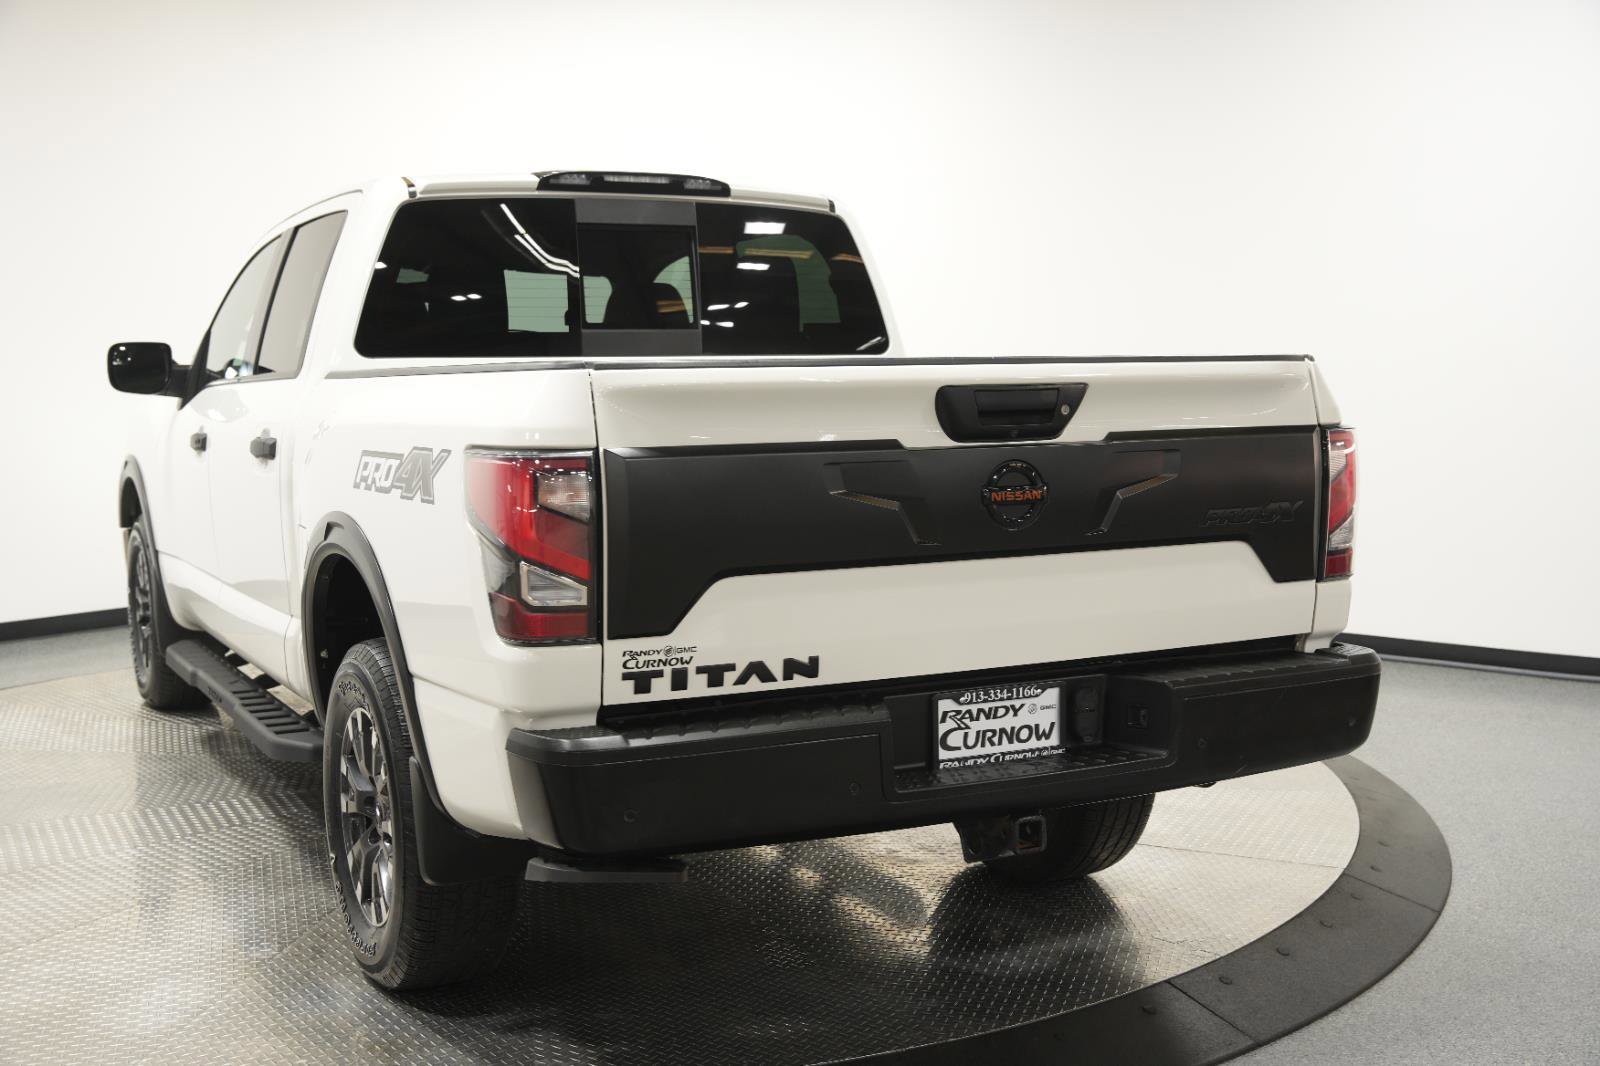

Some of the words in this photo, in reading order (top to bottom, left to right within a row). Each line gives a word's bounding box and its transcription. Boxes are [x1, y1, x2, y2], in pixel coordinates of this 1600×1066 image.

[991, 489, 1041, 502] NISSAN
[622, 649, 663, 658] RANDY
[676, 646, 698, 654] GMC
[622, 656, 693, 669] CURNOW
[622, 655, 819, 694] TITAN
[964, 686, 1037, 703] 913-334-1166
[940, 703, 1025, 727] RANDY
[940, 721, 1056, 751] CURNOW
